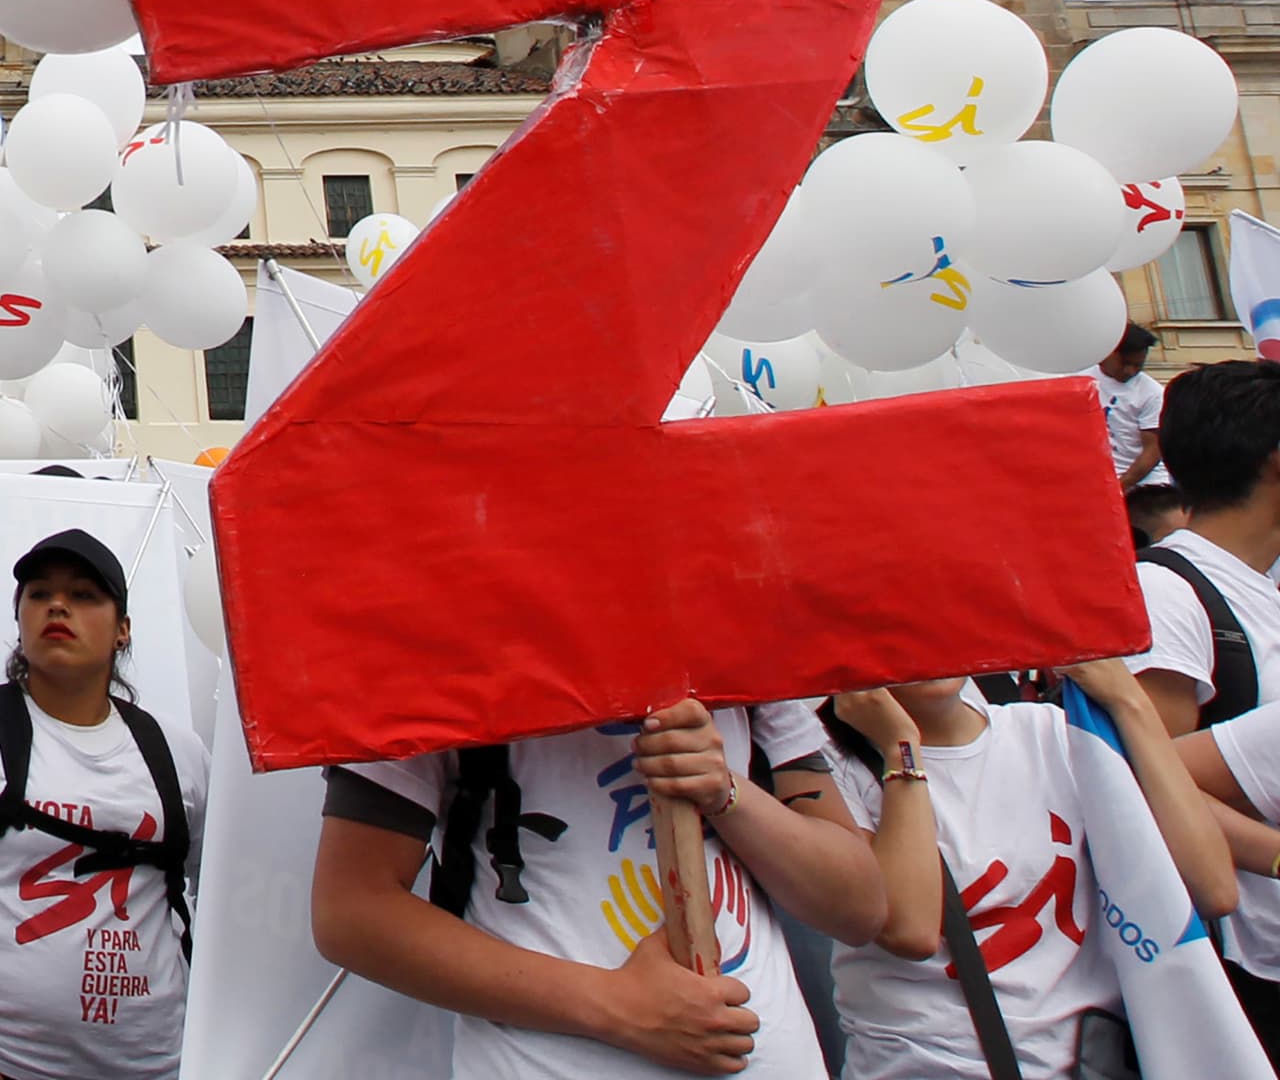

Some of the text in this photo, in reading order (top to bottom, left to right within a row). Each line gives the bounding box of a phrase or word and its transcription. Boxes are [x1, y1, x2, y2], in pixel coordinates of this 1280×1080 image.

[87, 928, 141, 951] Y PARA
[84, 951, 128, 973] ESTA
[81, 974, 150, 996] GUERRA
[80, 996, 118, 1024] YA!
